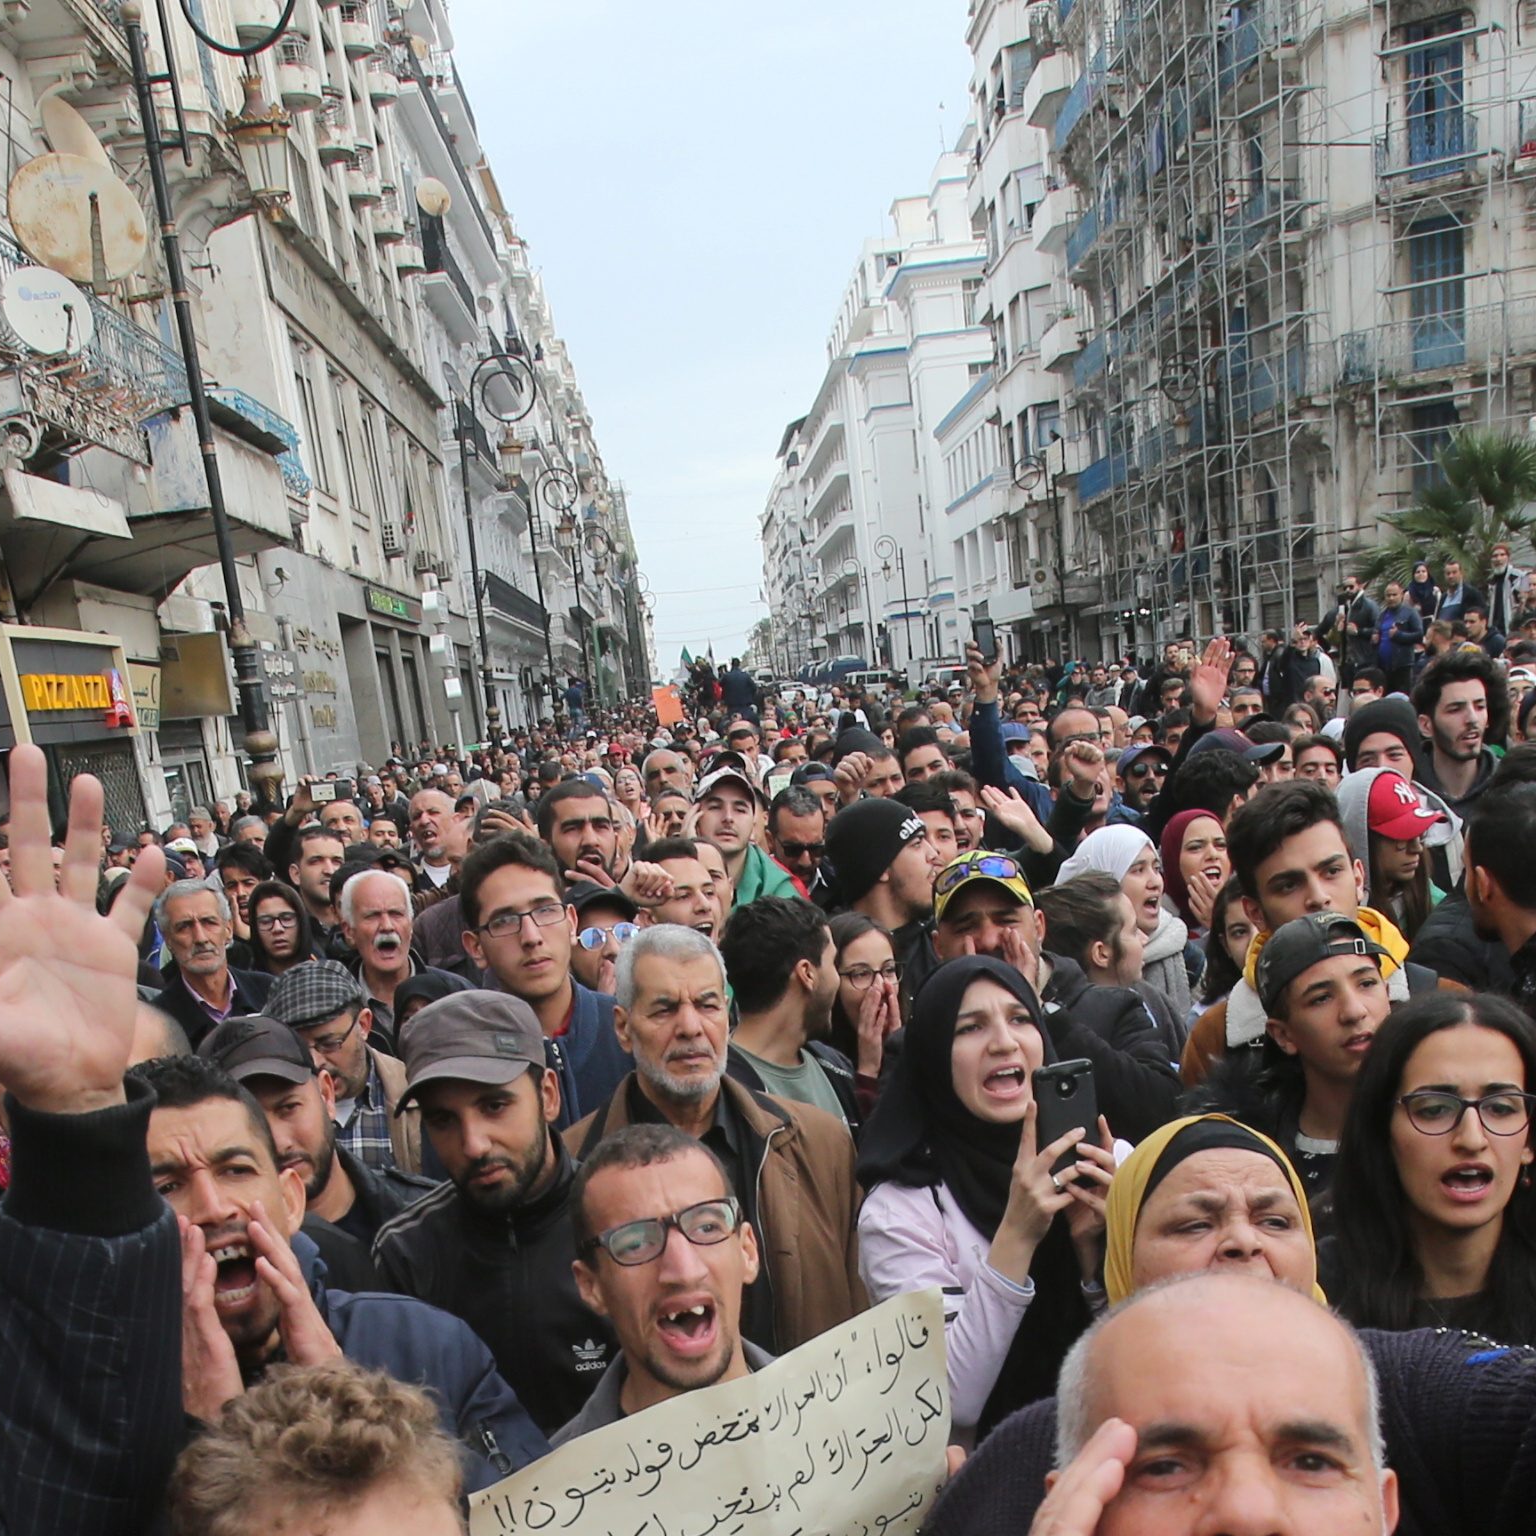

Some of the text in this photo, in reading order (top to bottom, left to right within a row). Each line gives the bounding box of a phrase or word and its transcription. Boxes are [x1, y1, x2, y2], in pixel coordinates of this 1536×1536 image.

[575, 1360, 607, 1372] adidas
[904, 1378, 944, 1446] لكن
[787, 1442, 816, 1512] لم
